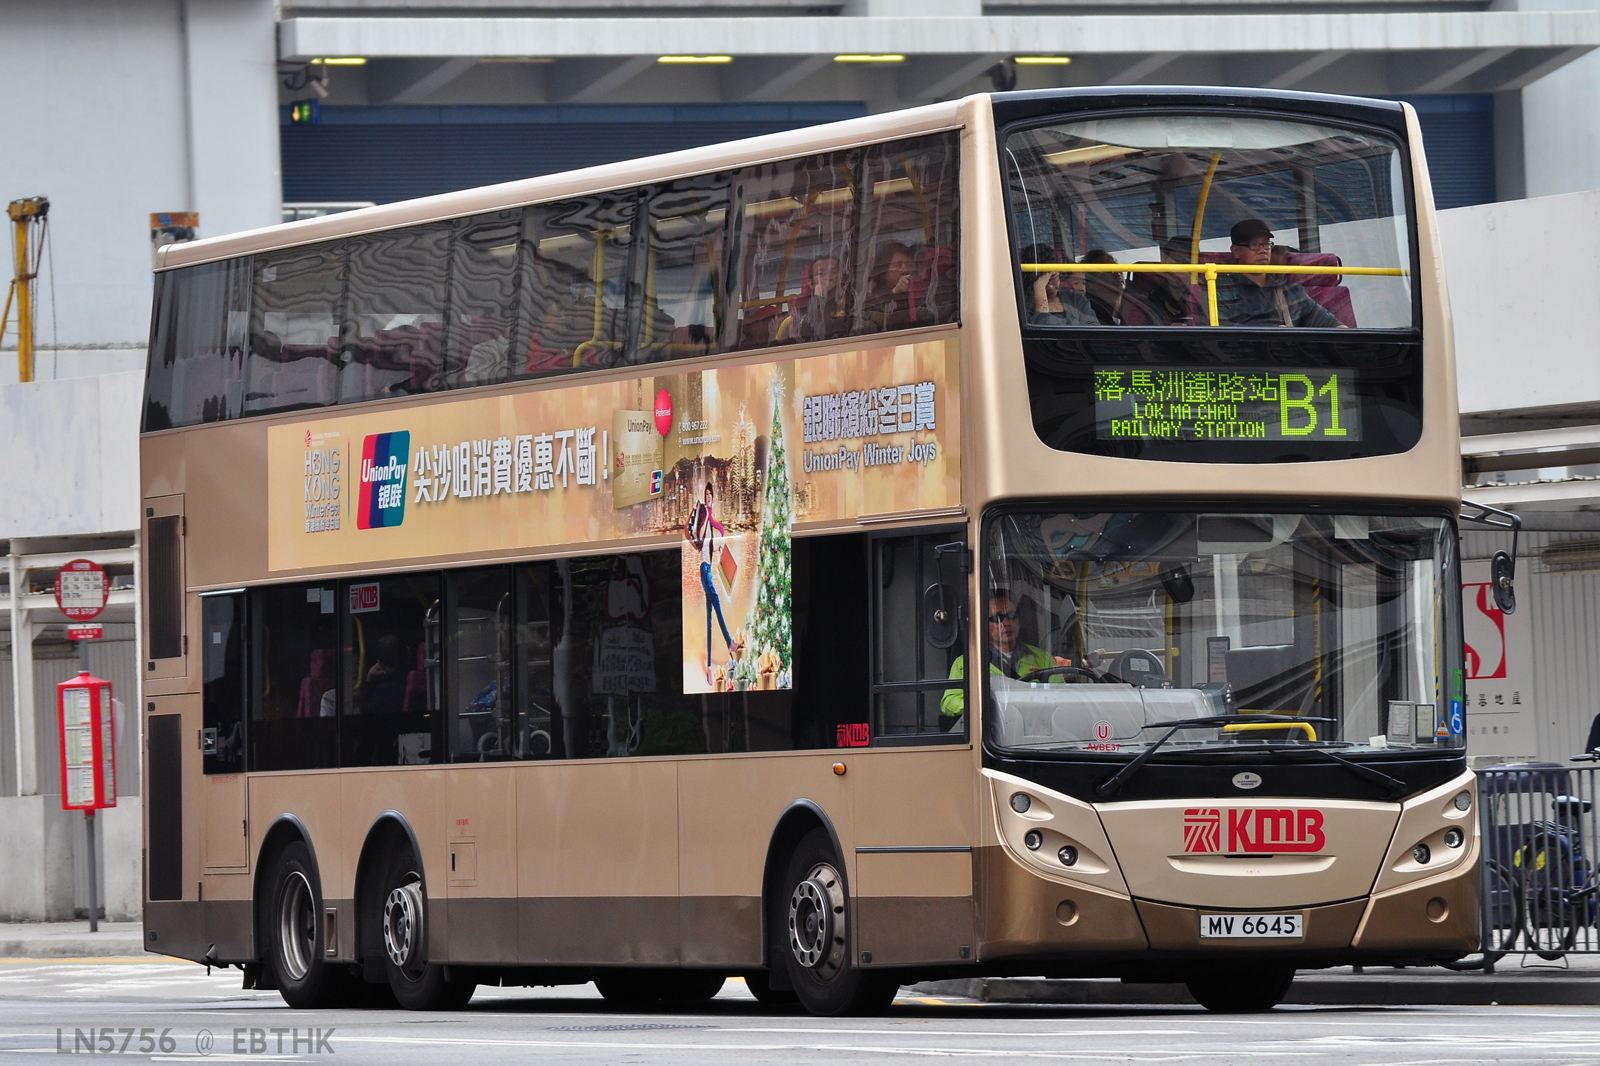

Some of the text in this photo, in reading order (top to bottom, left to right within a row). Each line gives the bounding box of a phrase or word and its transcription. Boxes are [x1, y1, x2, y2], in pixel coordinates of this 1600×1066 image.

[1094, 370, 1278, 403] 落馬洲鐵路站
[1134, 402, 1237, 420] LOK MA CHAU
[1279, 373, 1348, 436] B1
[627, 418, 653, 434] UnionPay
[1111, 420, 1265, 438] RAILWAY STATION
[304, 448, 340, 475] HONG
[802, 438, 936, 473] UnionPay Winter Joys
[361, 455, 406, 489] UnionPay
[304, 476, 340, 502] KONG
[378, 483, 402, 509] 银联
[846, 723, 870, 747] KMB
[1087, 743, 1121, 751] AVBE37
[1228, 809, 1326, 852] KMB
[1208, 916, 1296, 934] MV 6645
